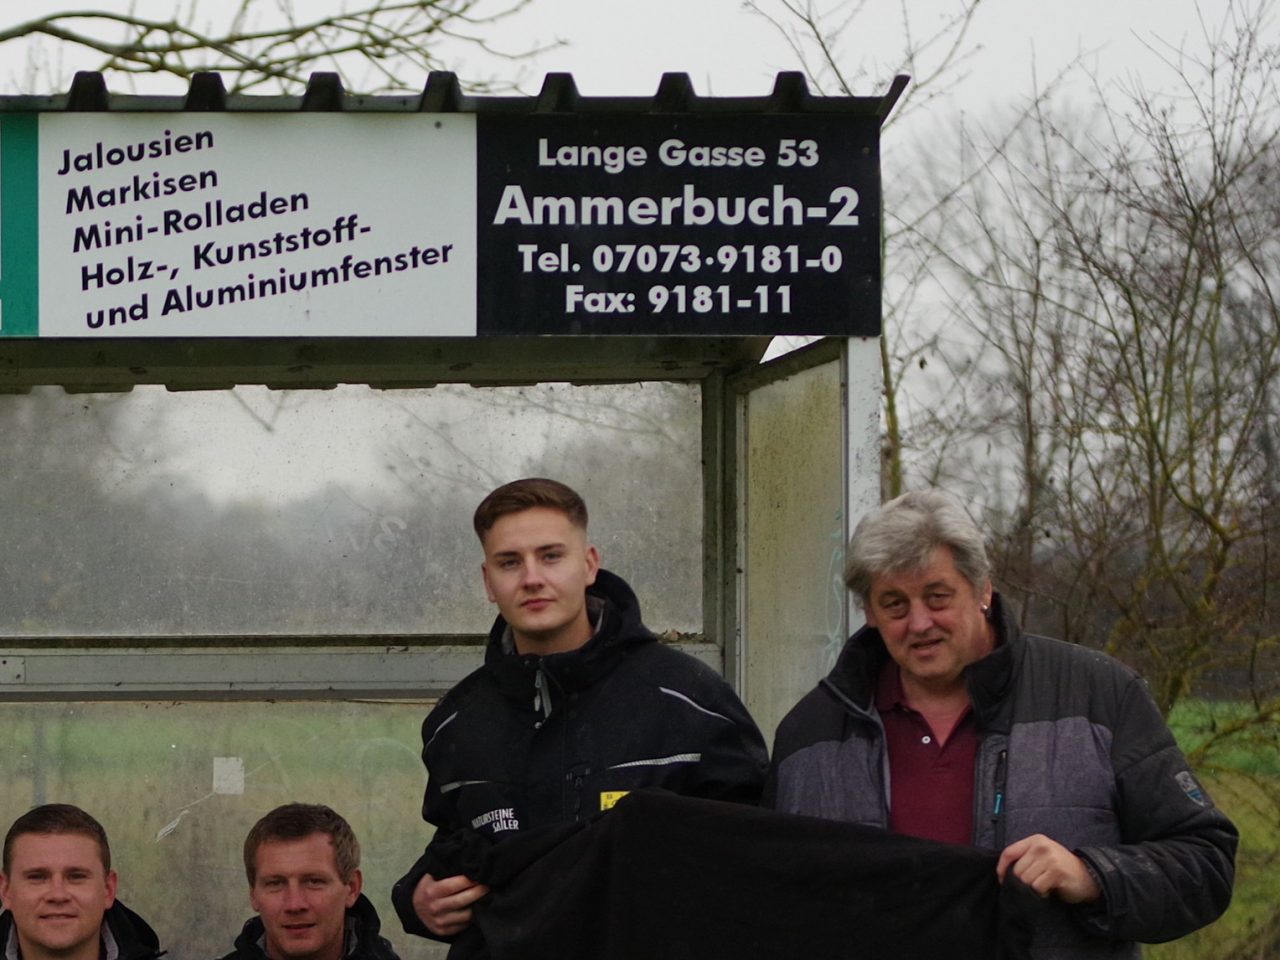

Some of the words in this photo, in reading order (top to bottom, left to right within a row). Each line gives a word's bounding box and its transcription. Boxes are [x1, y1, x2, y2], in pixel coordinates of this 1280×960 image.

[57, 129, 214, 176] Jalousien
[538, 138, 647, 174] Lange
[659, 139, 766, 167] Gasse
[777, 139, 820, 167] 53
[66, 169, 218, 214] Markisen
[493, 184, 859, 226] Ammerbuch-2
[73, 191, 309, 253] Mini-Rolladen
[81, 256, 180, 291] Holz-,
[193, 214, 371, 270] Kunststoff-
[518, 244, 581, 273] Tel.
[86, 293, 148, 329] und
[161, 244, 453, 316] Aluminiumfenster
[566, 285, 636, 313] Fax:
[648, 285, 791, 313] 9181-11
[492, 819, 520, 833] SAILER
